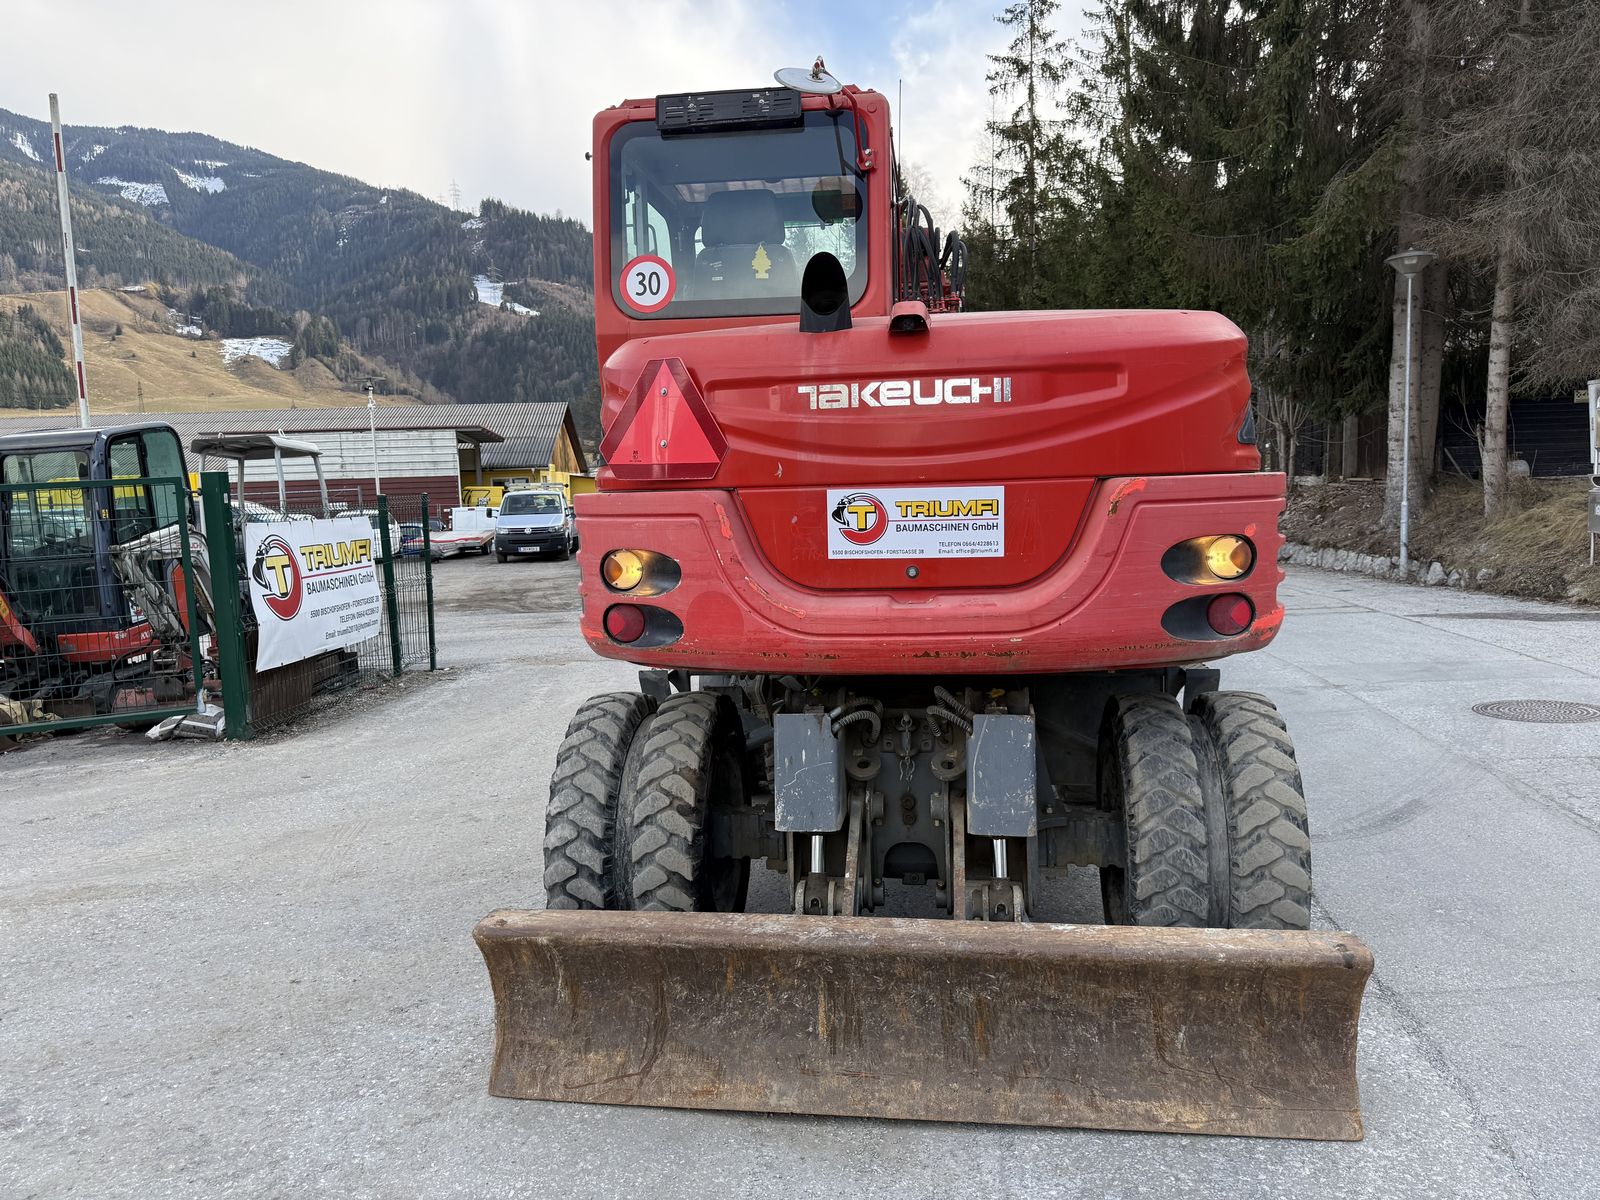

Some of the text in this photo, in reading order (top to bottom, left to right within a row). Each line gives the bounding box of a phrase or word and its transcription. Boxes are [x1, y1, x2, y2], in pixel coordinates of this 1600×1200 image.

[635, 271, 661, 296] 30
[895, 499, 1000, 518] TRIUMFI
[895, 522, 999, 533] BAUMASCHINEN GmbH
[300, 538, 372, 571] TRIUMFI
[306, 571, 375, 595] BAUMASCHINEN GmbH
[321, 602, 351, 616] BISCHOFSHOFEN
[339, 613, 356, 624] TELEFON
